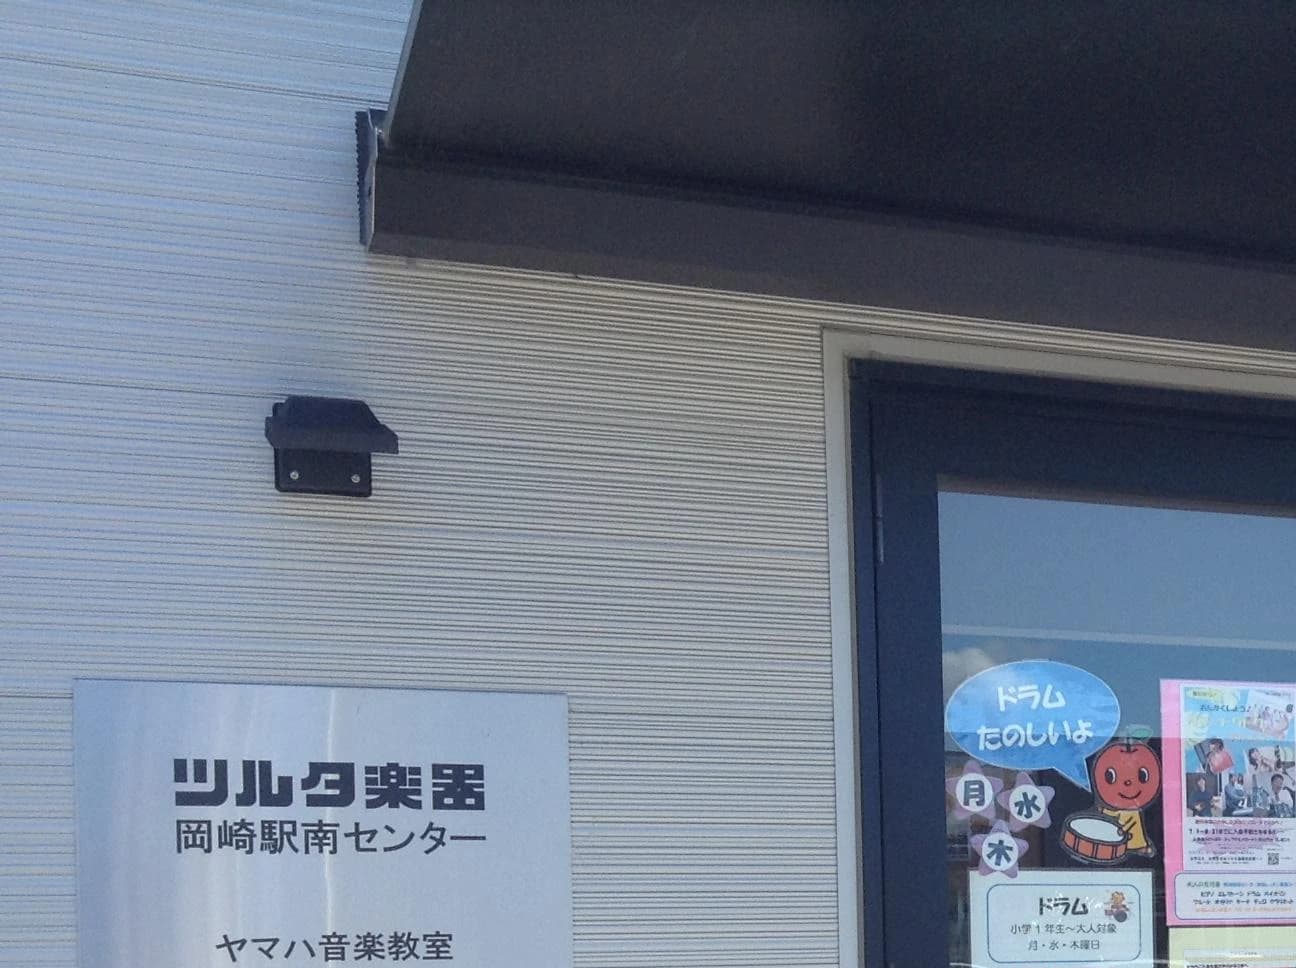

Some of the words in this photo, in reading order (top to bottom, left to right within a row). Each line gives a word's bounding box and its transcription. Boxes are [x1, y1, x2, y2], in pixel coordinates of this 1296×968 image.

[996, 684, 1066, 712] ドラム
[976, 719, 1094, 751] たのしいよ
[172, 757, 486, 812] ツルタ楽器
[962, 779, 987, 806] 月
[1013, 791, 1042, 818] 水
[175, 818, 488, 857] 岡崎駅南センター
[986, 838, 1014, 867] 木
[1038, 897, 1089, 916] ドラム
[215, 930, 454, 965] ヤマハ音楽教室
